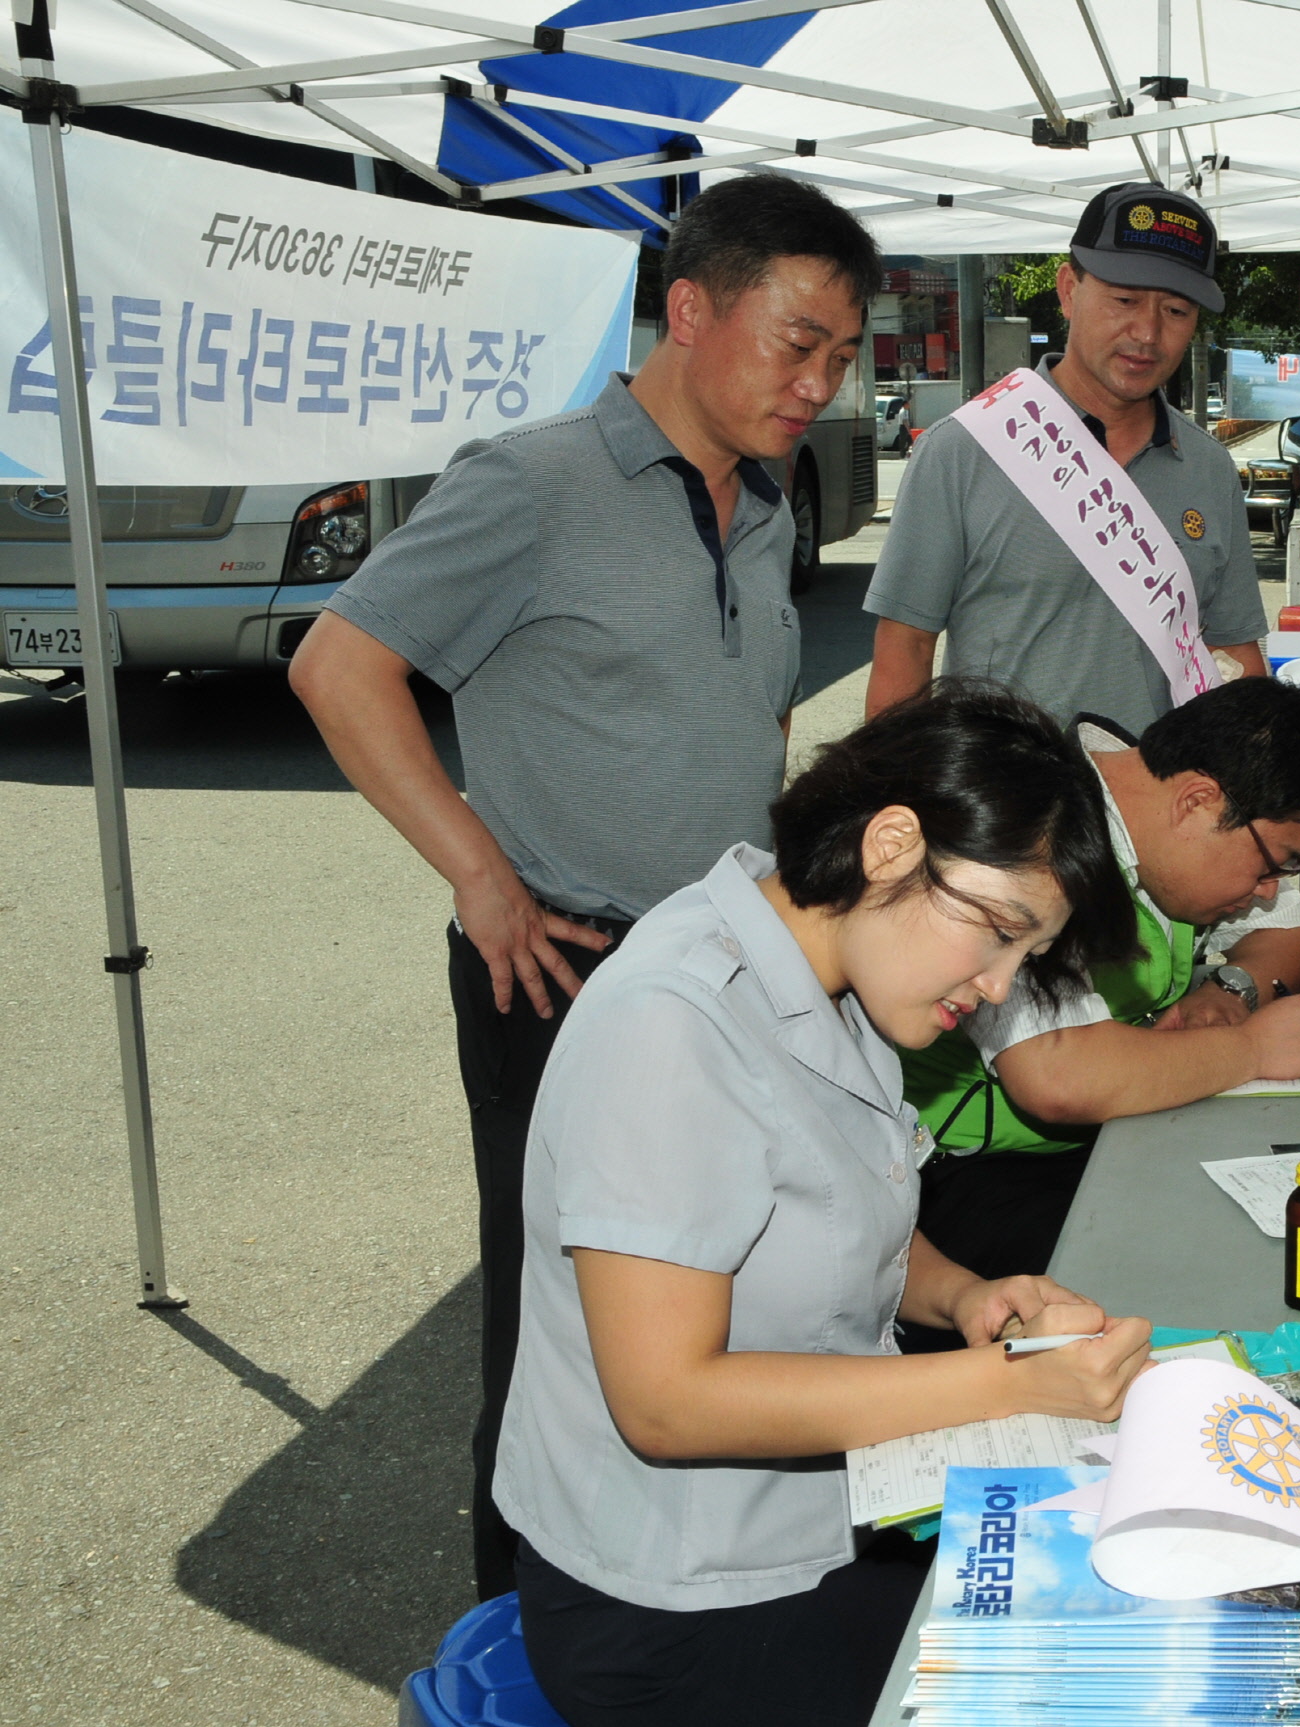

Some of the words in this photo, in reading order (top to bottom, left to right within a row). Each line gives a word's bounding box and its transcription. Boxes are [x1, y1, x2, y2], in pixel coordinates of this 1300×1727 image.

[1152, 221, 1185, 237] ABOVE
[1161, 211, 1199, 231] SERVICE
[1123, 230, 1149, 244] THE
[219, 562, 267, 571] H380
[9, 629, 113, 653] 74부23
[1216, 1412, 1235, 1458] ROTARY
[956, 1546, 977, 1580] Korea
[952, 1582, 977, 1608] Rotary
